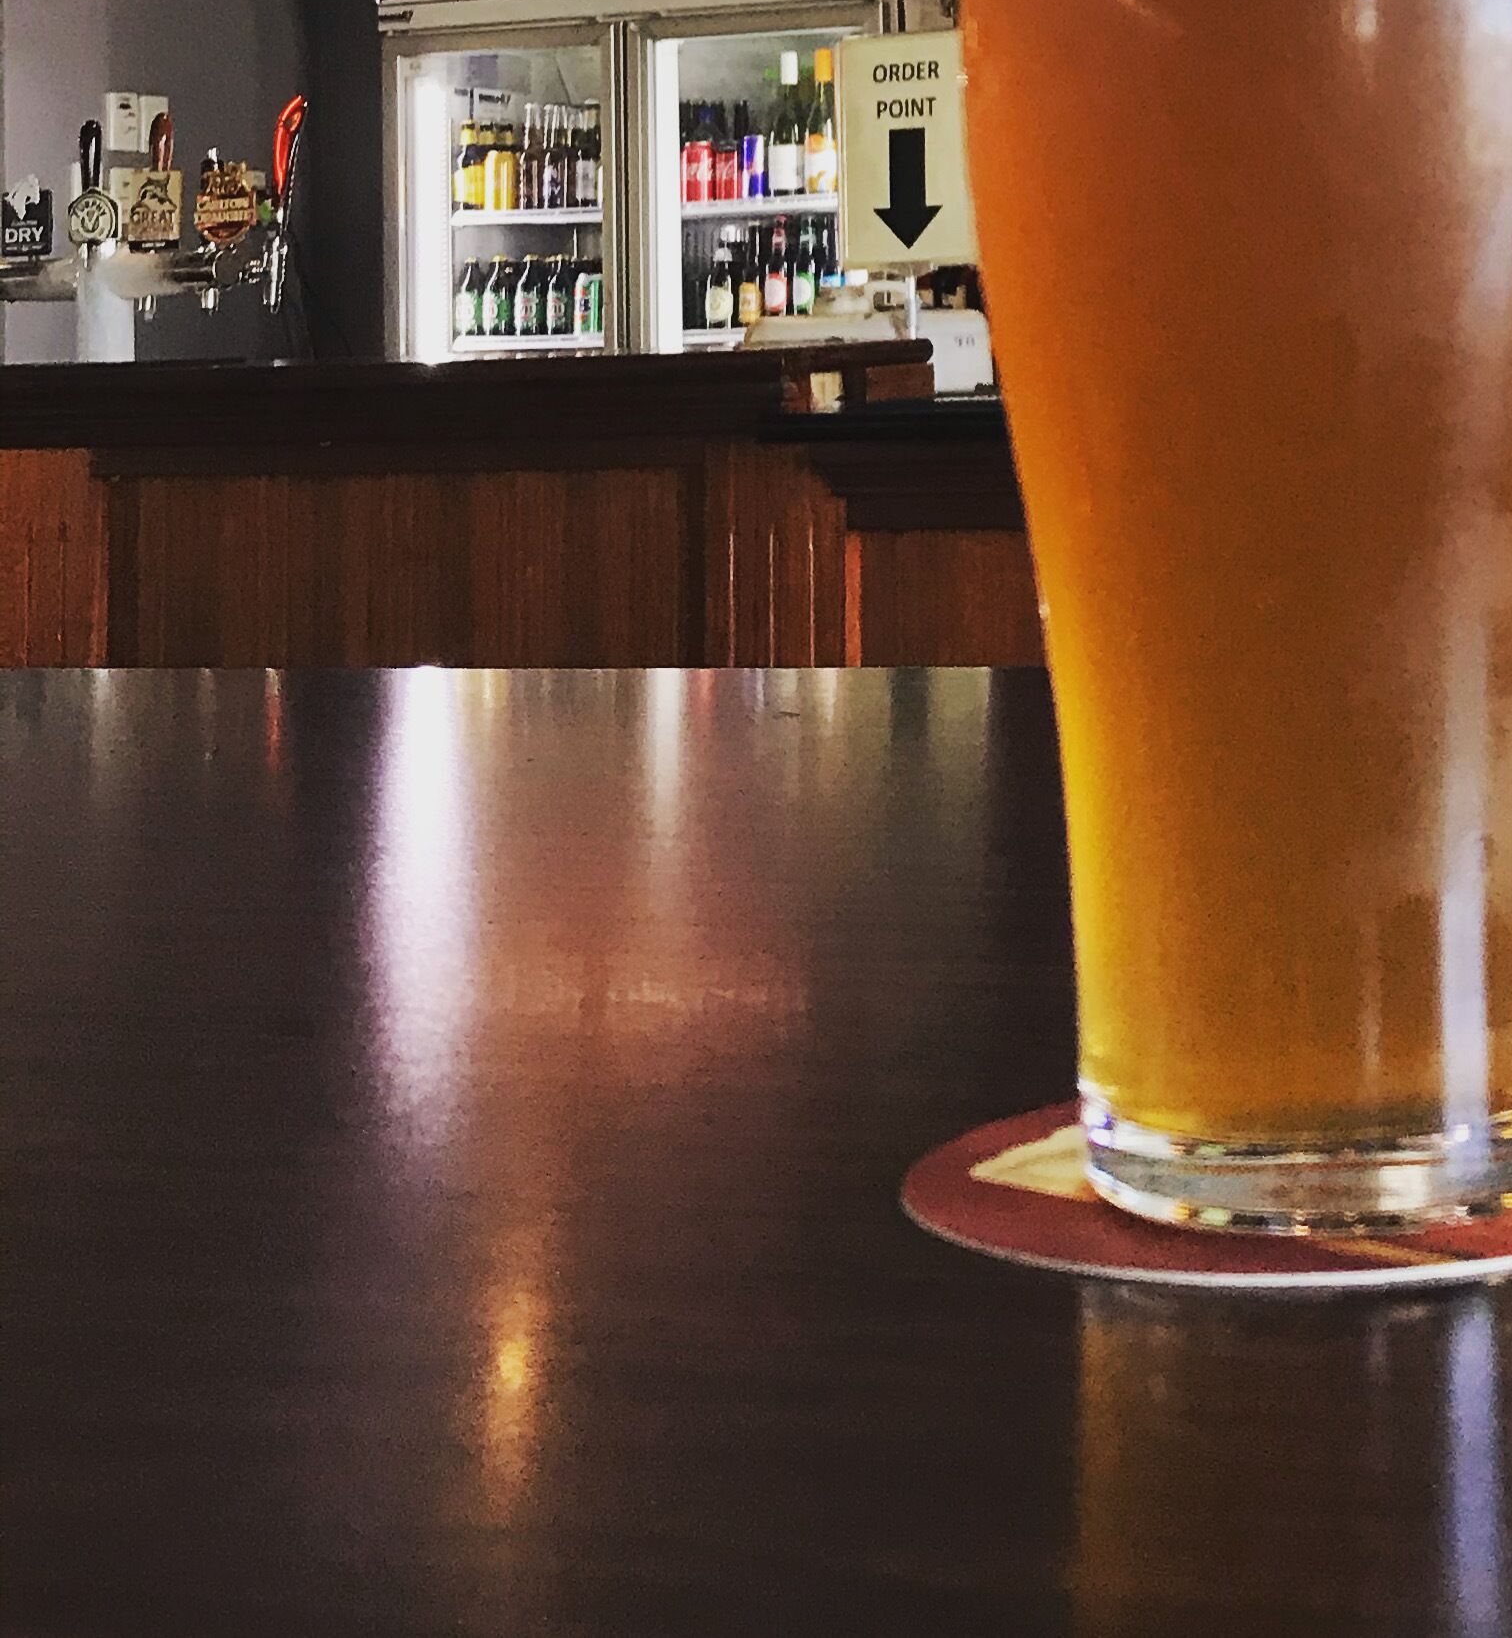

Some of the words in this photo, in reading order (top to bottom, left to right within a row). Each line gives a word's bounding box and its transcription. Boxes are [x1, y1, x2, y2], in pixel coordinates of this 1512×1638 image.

[872, 61, 940, 83] ORDER
[876, 96, 936, 118] POINT
[132, 211, 176, 224] GREAT
[5, 228, 43, 243] DRY
